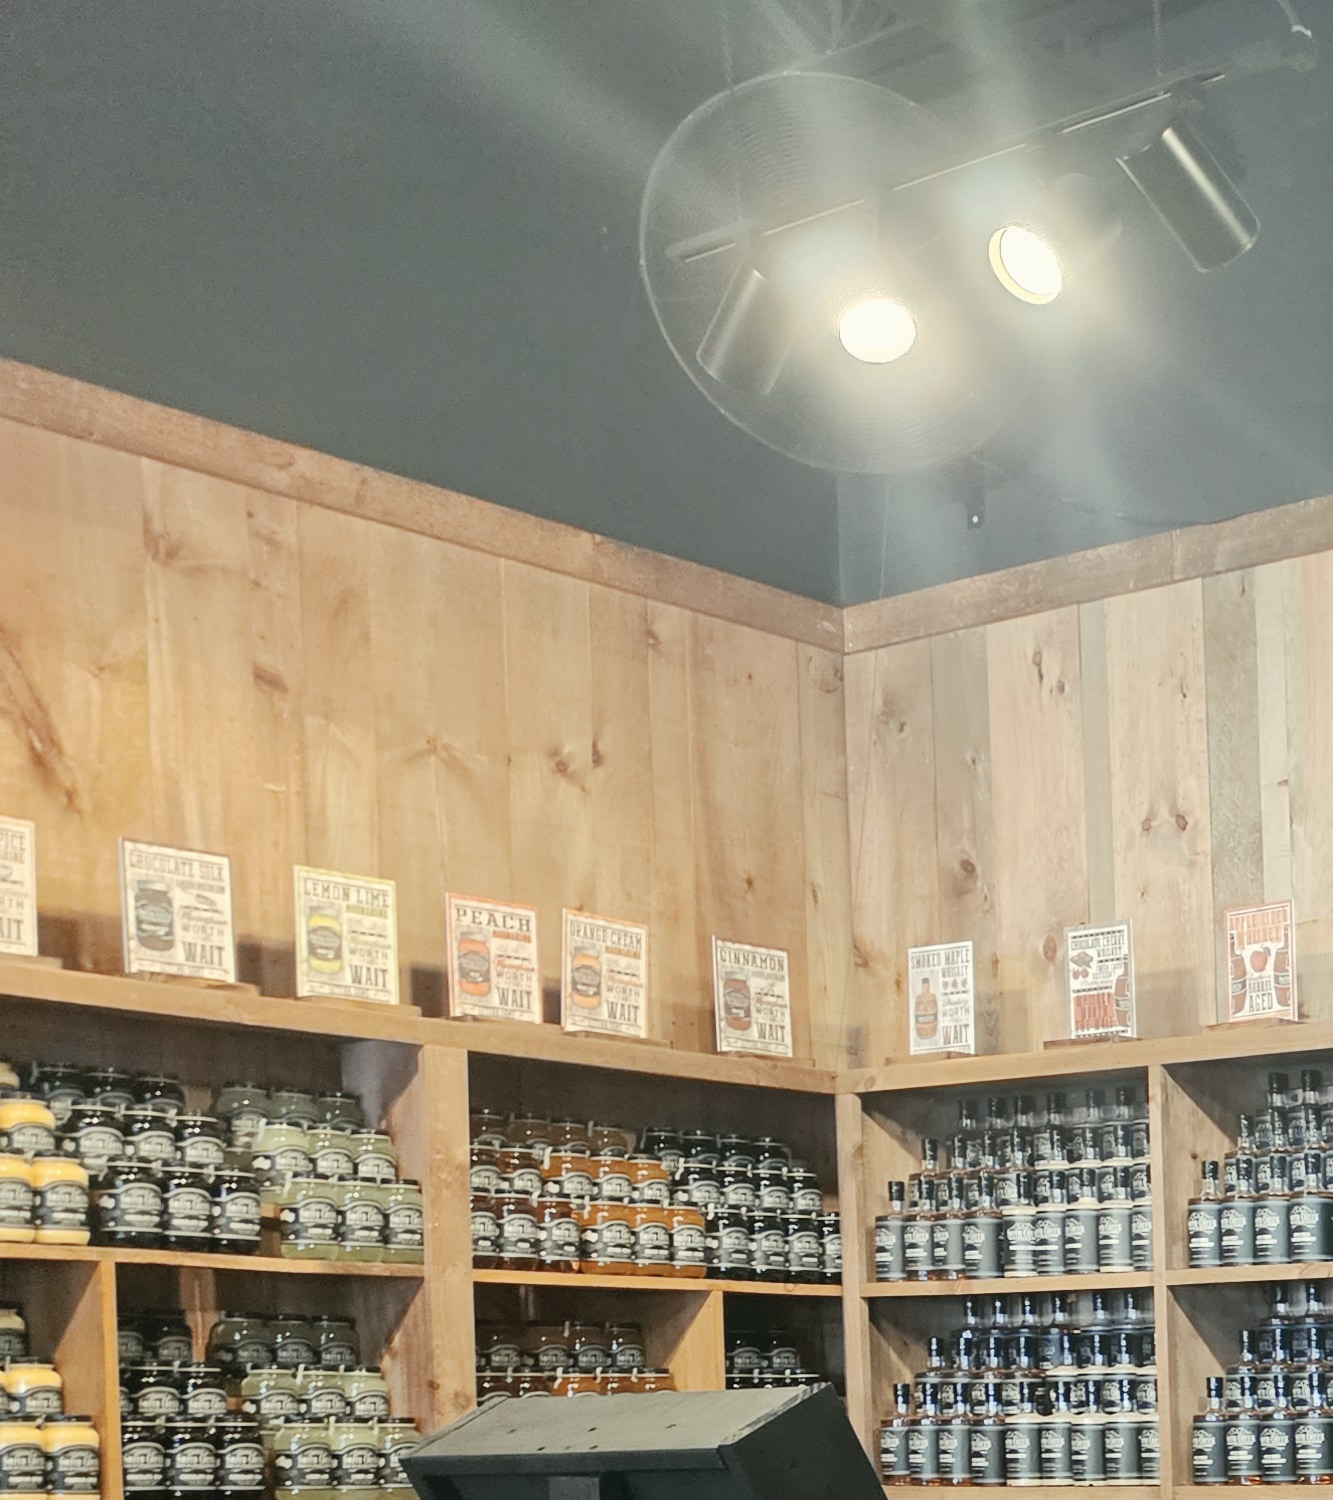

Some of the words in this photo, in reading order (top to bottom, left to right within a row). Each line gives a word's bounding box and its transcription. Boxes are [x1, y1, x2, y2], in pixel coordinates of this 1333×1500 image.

[303, 880, 350, 902] LEMON
[356, 889, 389, 908] LIME
[455, 908, 532, 933] PEACH
[570, 922, 607, 943] ORANGE
[611, 931, 642, 950] CREAM
[182, 940, 225, 967] WAIT
[349, 947, 388, 960] WORTH
[720, 949, 784, 972] CINNAMON
[911, 952, 941, 970] SMOKED
[944, 949, 970, 965] MAPLE
[349, 964, 388, 988] WAIT
[496, 969, 532, 982] WORTH
[606, 984, 640, 997] WORTH
[1248, 980, 1272, 994] BARREL
[497, 986, 532, 1010] WAIT
[1249, 993, 1273, 1013] AGED
[607, 1001, 639, 1023] WAIT
[942, 1007, 970, 1017] WORTH
[757, 1022, 786, 1043] WAIT
[942, 1024, 970, 1045] WAIT
